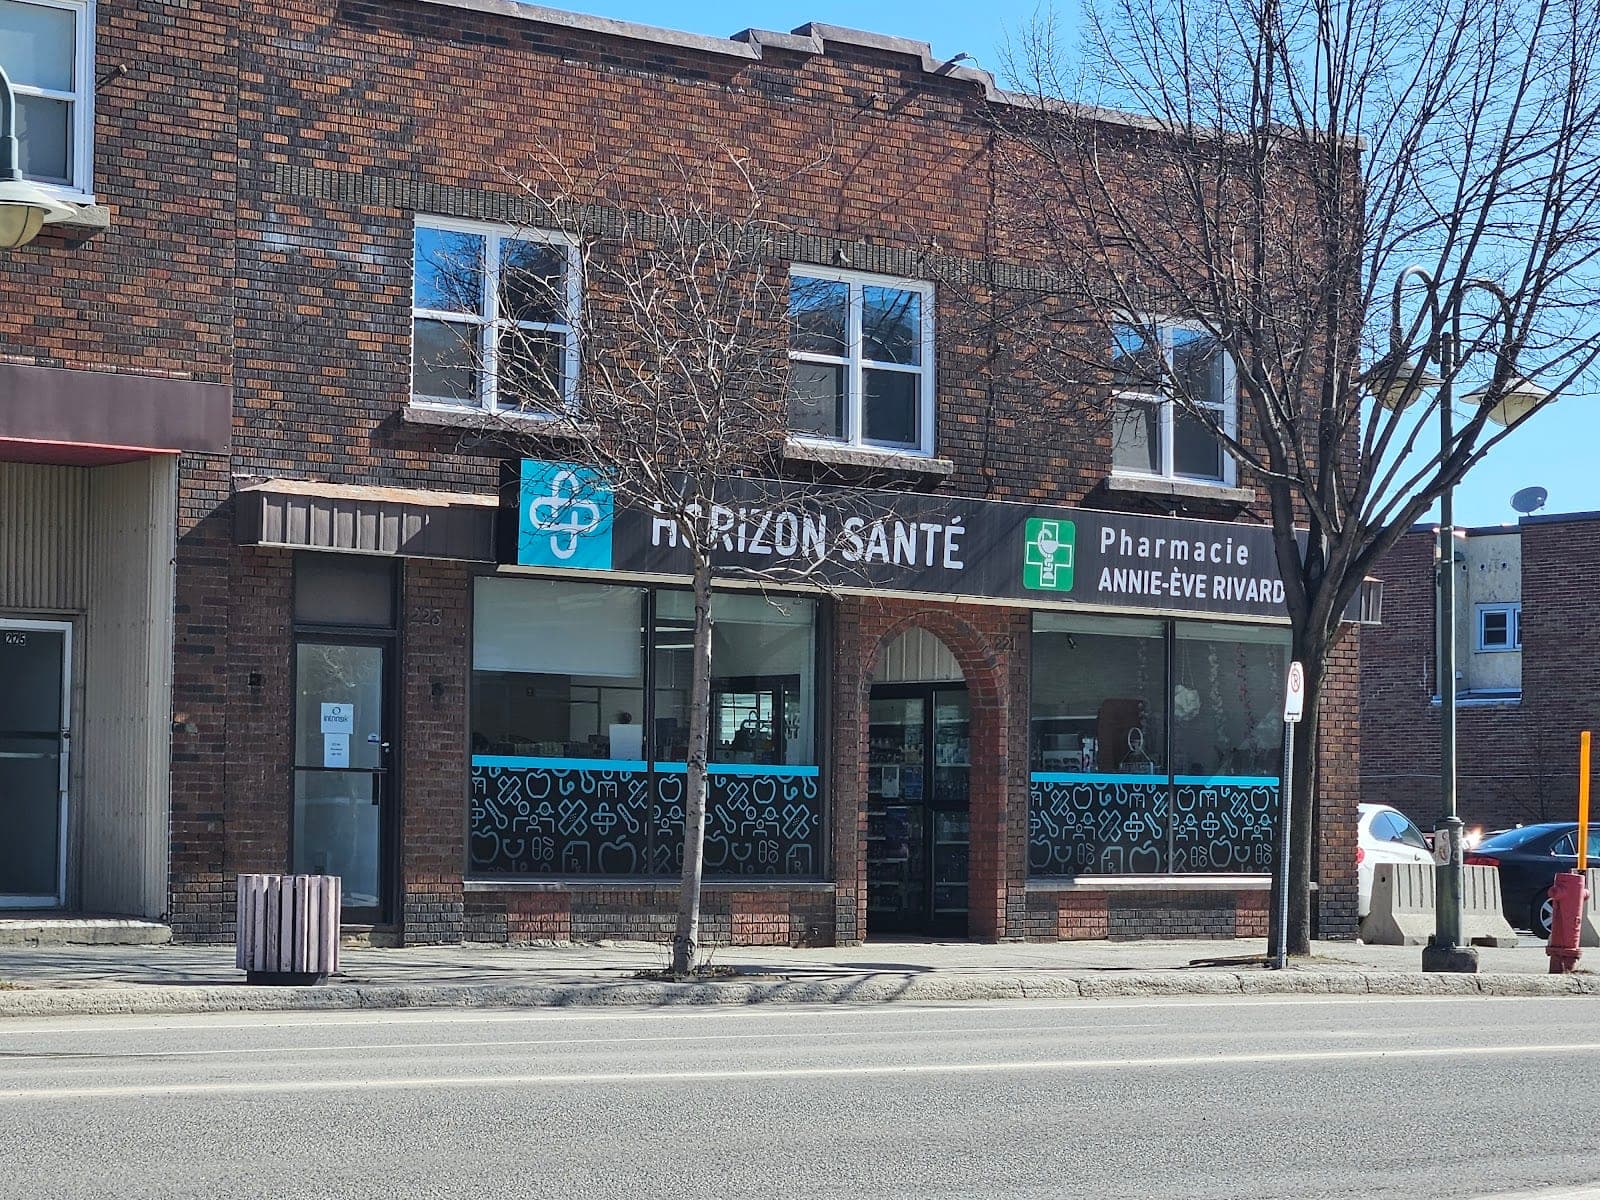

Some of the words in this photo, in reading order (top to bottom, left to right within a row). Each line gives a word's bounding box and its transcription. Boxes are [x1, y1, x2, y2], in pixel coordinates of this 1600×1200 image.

[842, 515, 965, 570] SANTÉ
[1101, 528, 1249, 565] Pharmacie
[1098, 566, 1206, 598] ANNIE-ÈVE
[1213, 576, 1285, 604] RIVARD
